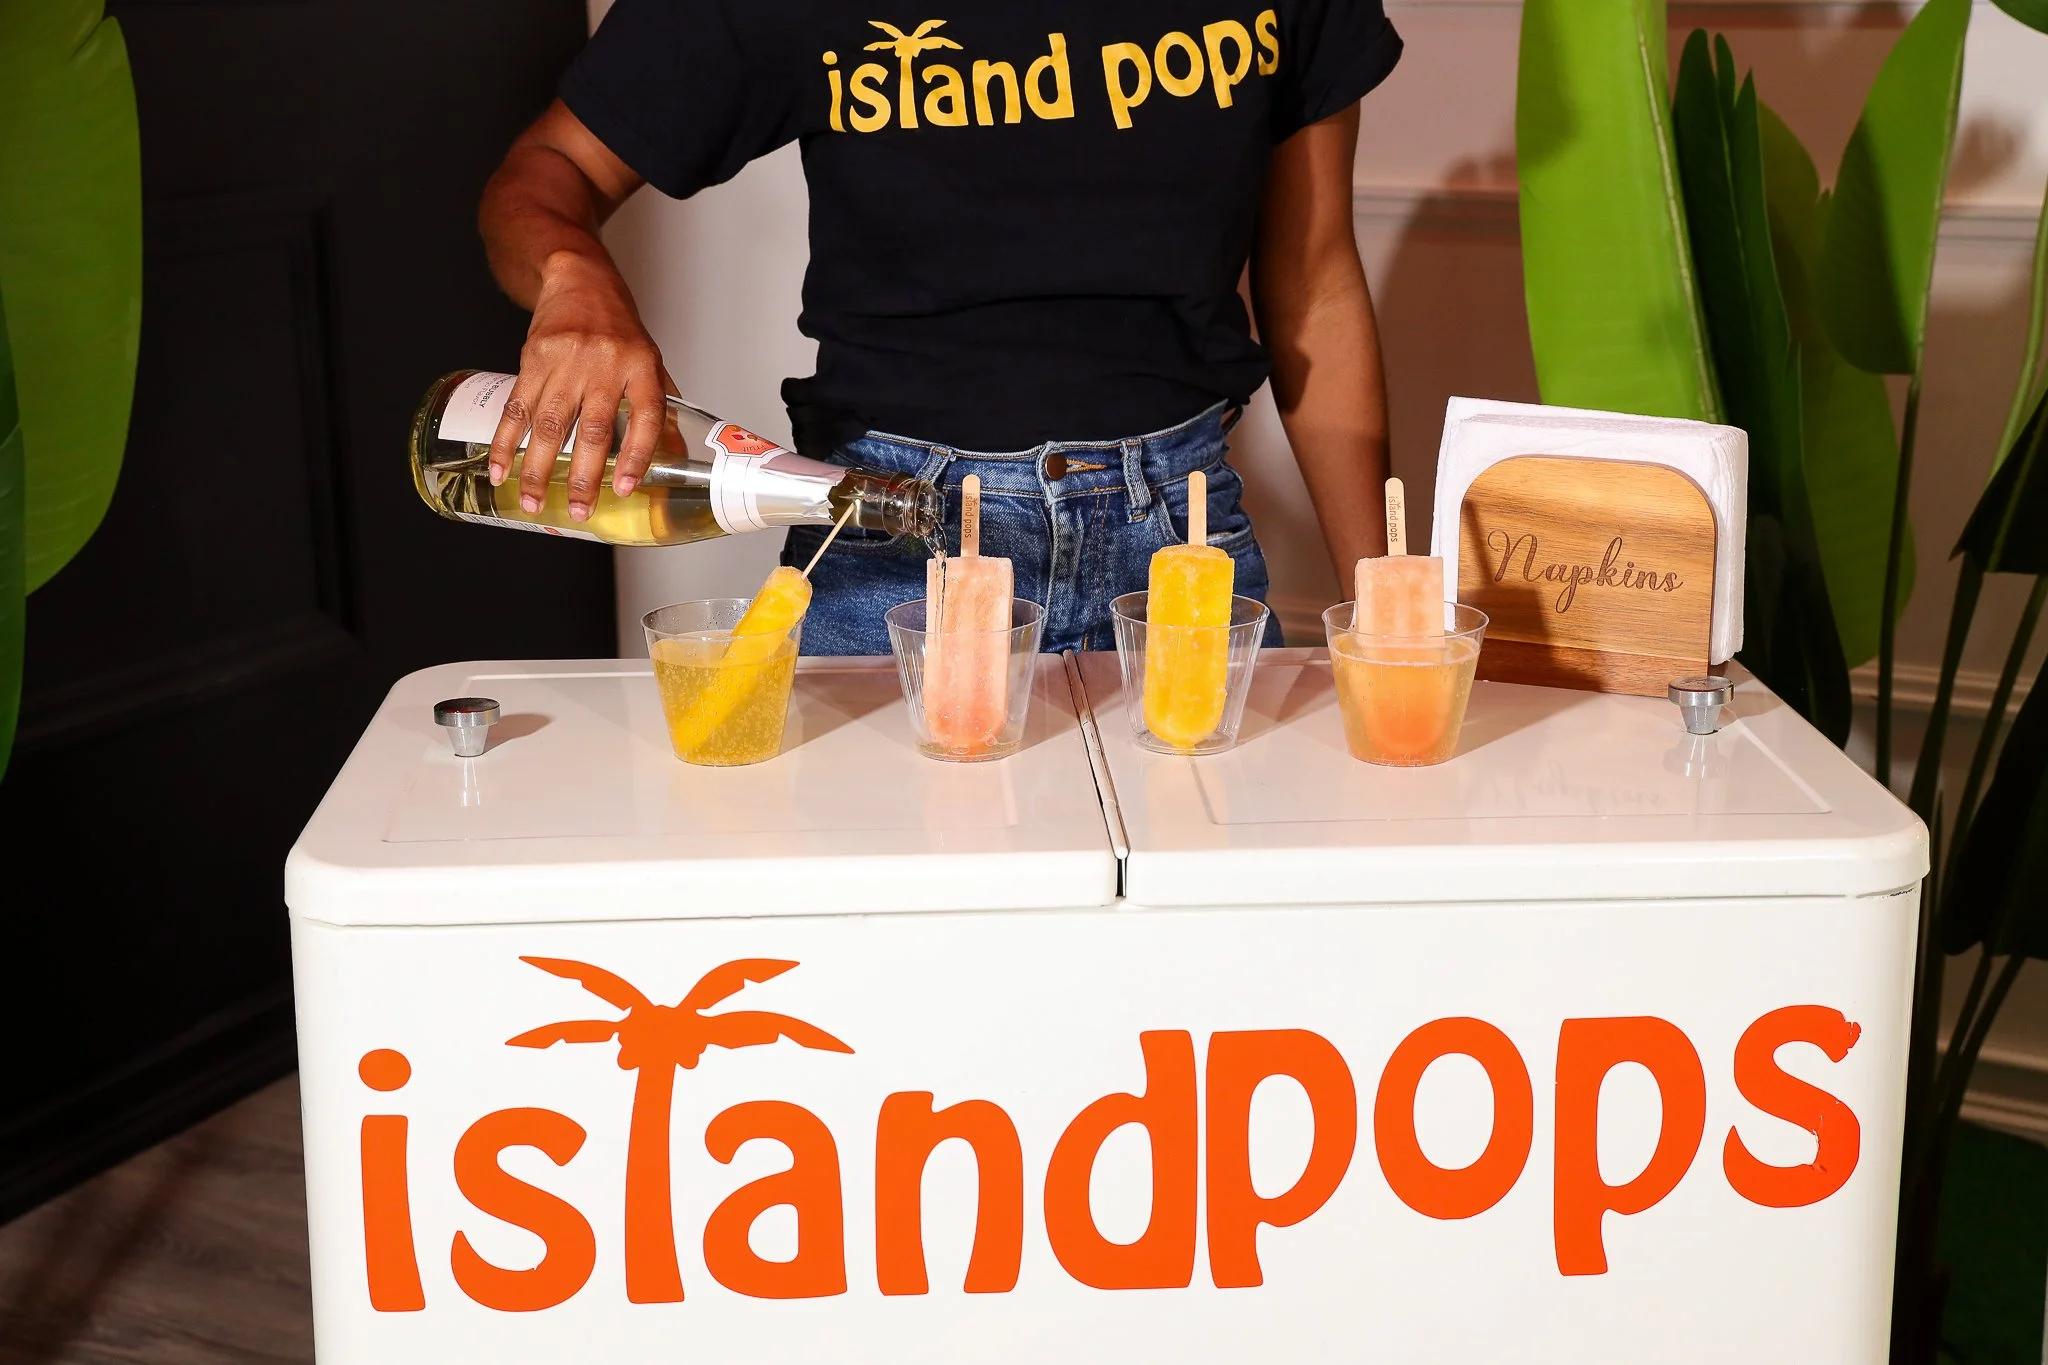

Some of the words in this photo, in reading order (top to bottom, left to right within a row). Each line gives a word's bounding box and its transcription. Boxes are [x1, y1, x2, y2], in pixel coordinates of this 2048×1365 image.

[822, 19, 1075, 133] island
[1102, 8, 1280, 129] pops
[965, 493, 977, 517] island
[1388, 496, 1401, 521] island
[964, 519, 972, 538] pops
[1388, 523, 1398, 542] pops
[1488, 528, 1684, 614] Napkins
